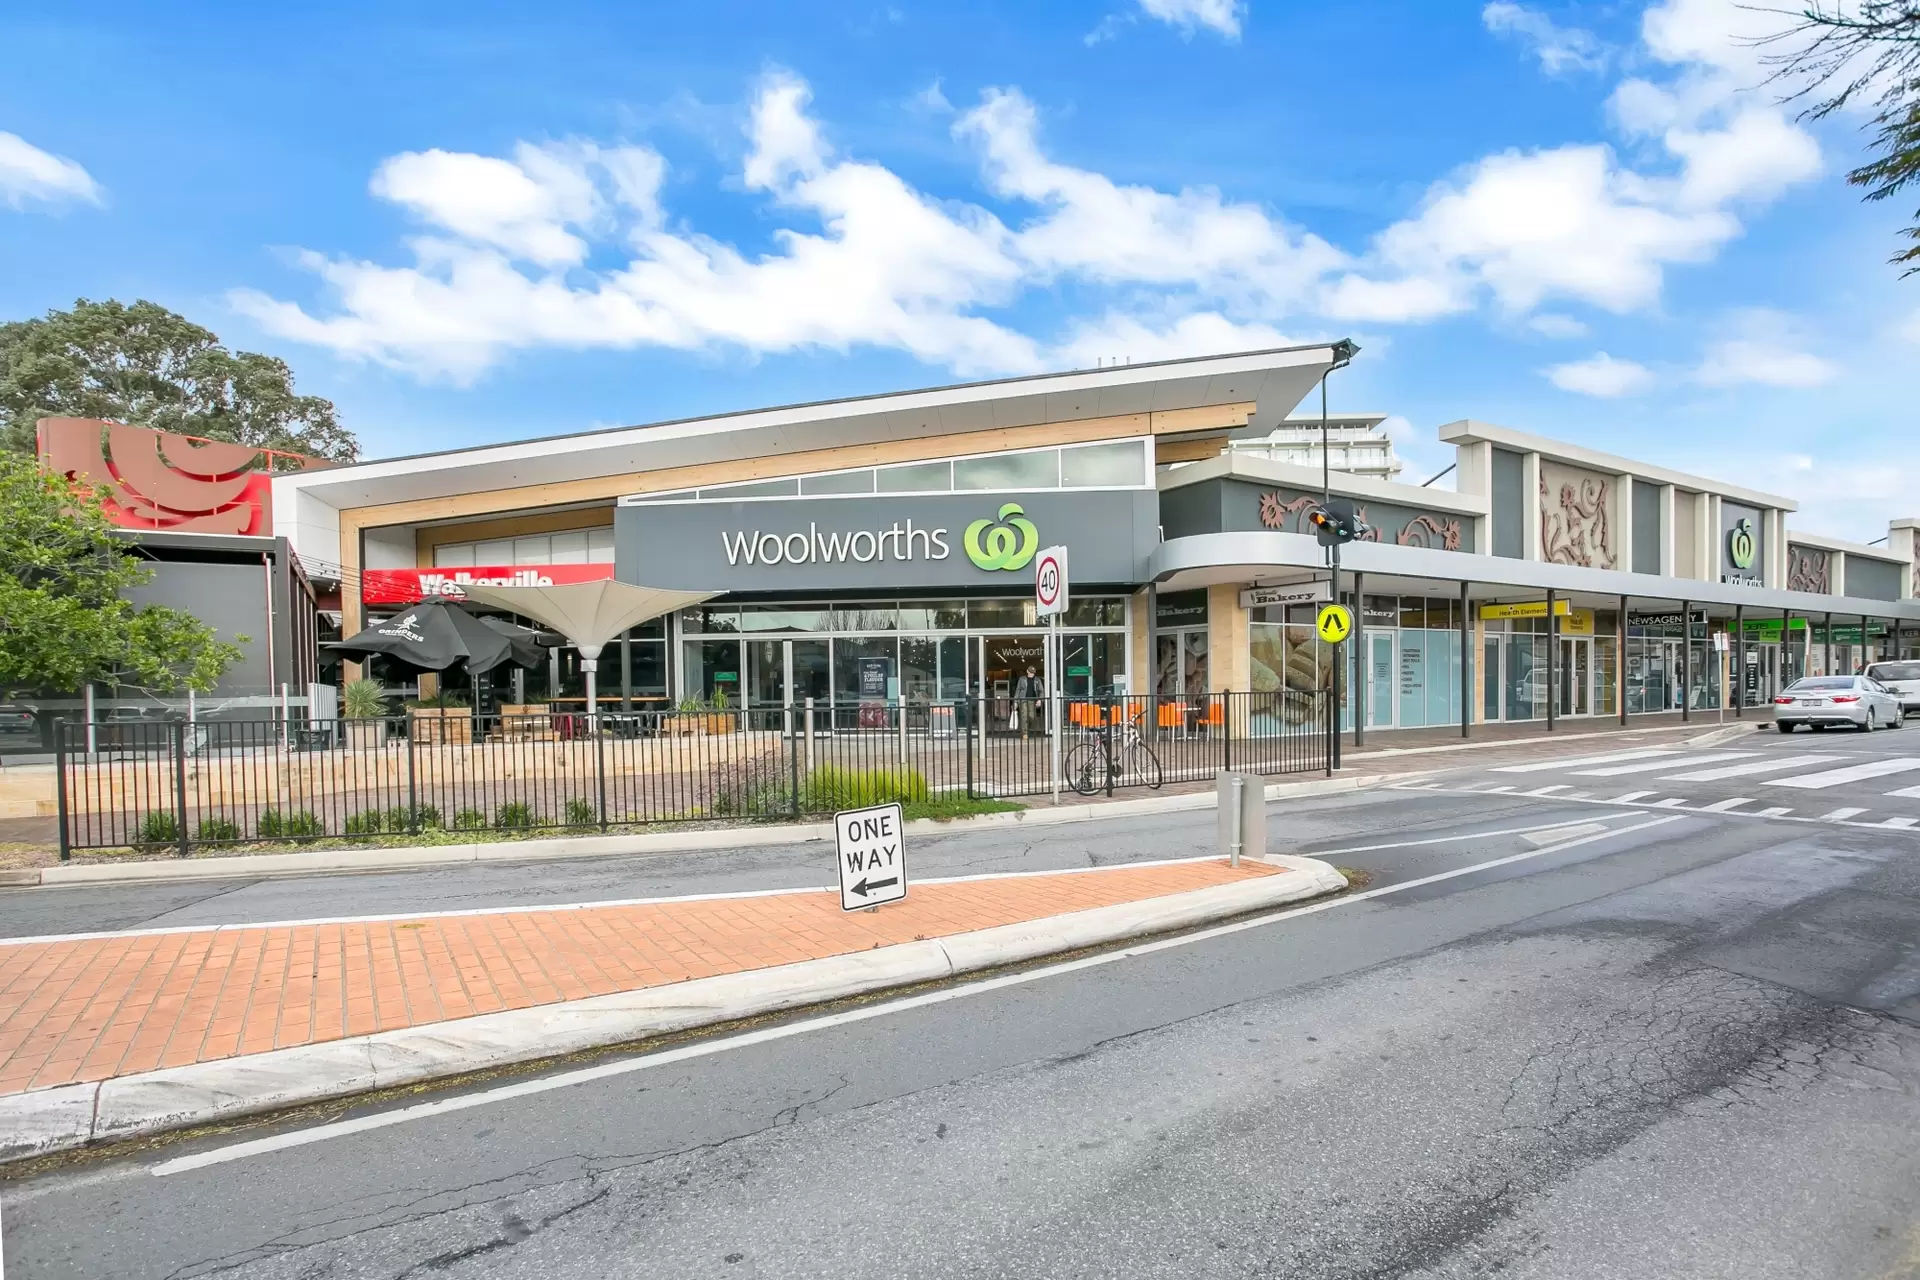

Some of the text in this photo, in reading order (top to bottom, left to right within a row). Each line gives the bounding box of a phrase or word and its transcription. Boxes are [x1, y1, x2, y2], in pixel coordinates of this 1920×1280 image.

[722, 519, 950, 566] Woolworths
[1041, 570, 1056, 592] 40
[1256, 592, 1316, 604] Bakery
[1157, 606, 1205, 617] Bakery
[1362, 609, 1395, 618] akery
[1628, 614, 1697, 626] NEWSAGENY
[378, 629, 424, 642] GRINDERS
[1002, 647, 1045, 657] Woolworth
[848, 815, 893, 843] ONE
[846, 843, 897, 874] WAY
